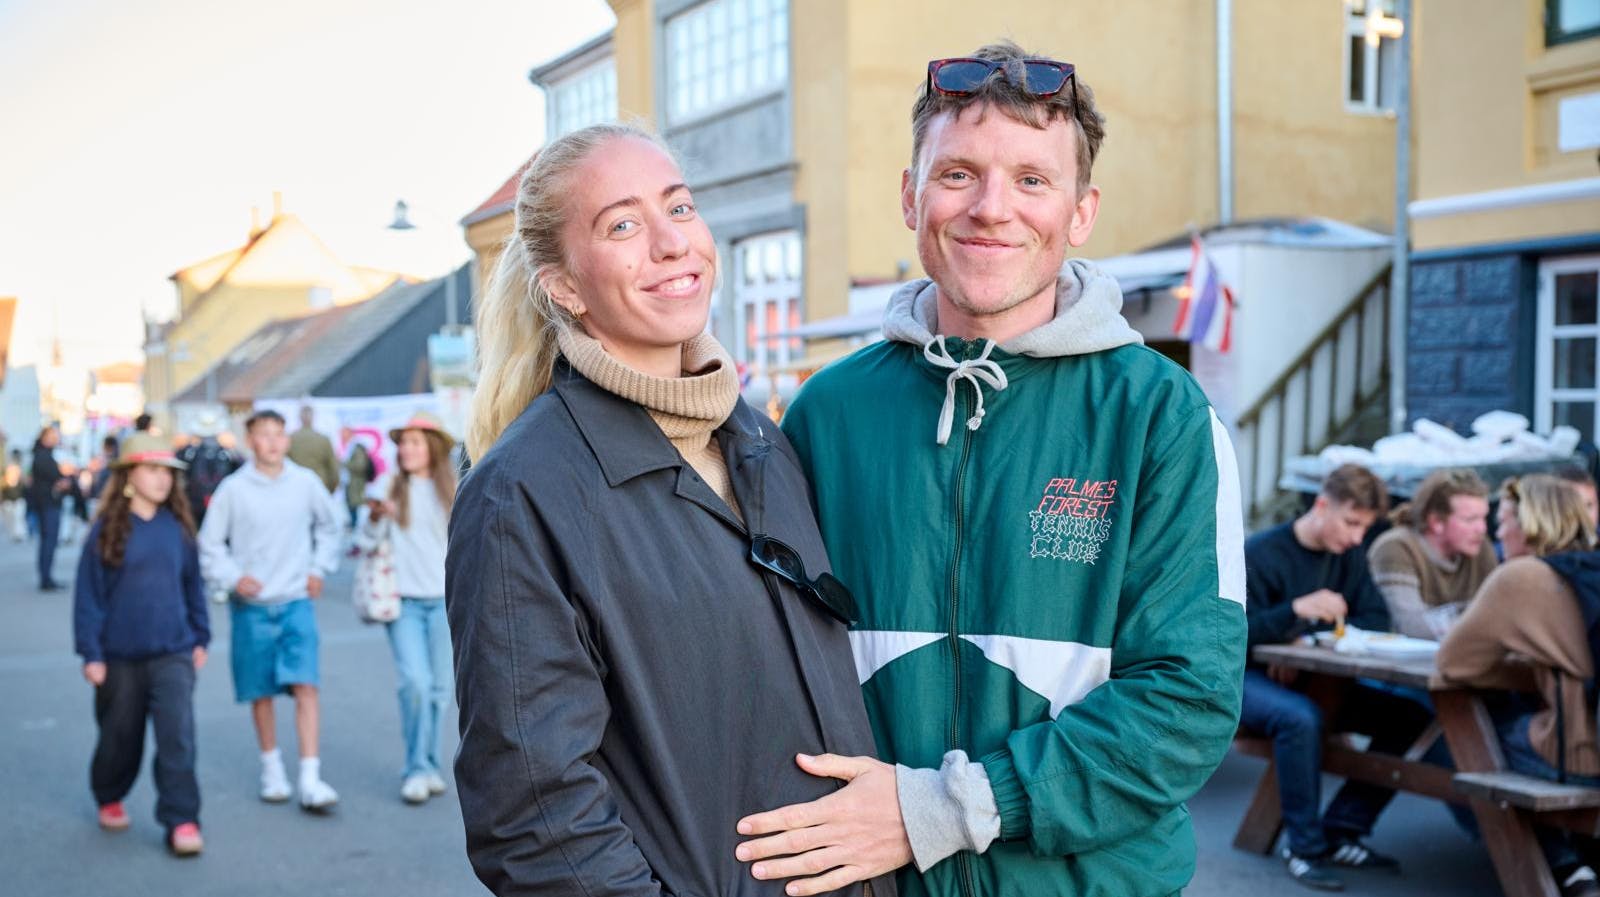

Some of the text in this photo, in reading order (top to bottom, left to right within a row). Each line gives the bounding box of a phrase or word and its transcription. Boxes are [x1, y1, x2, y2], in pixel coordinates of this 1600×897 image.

[1044, 478, 1117, 499] PALMES
[1038, 495, 1114, 519] FOREST
[1028, 510, 1113, 543] TENNIS
[1030, 532, 1102, 565] CLUB
